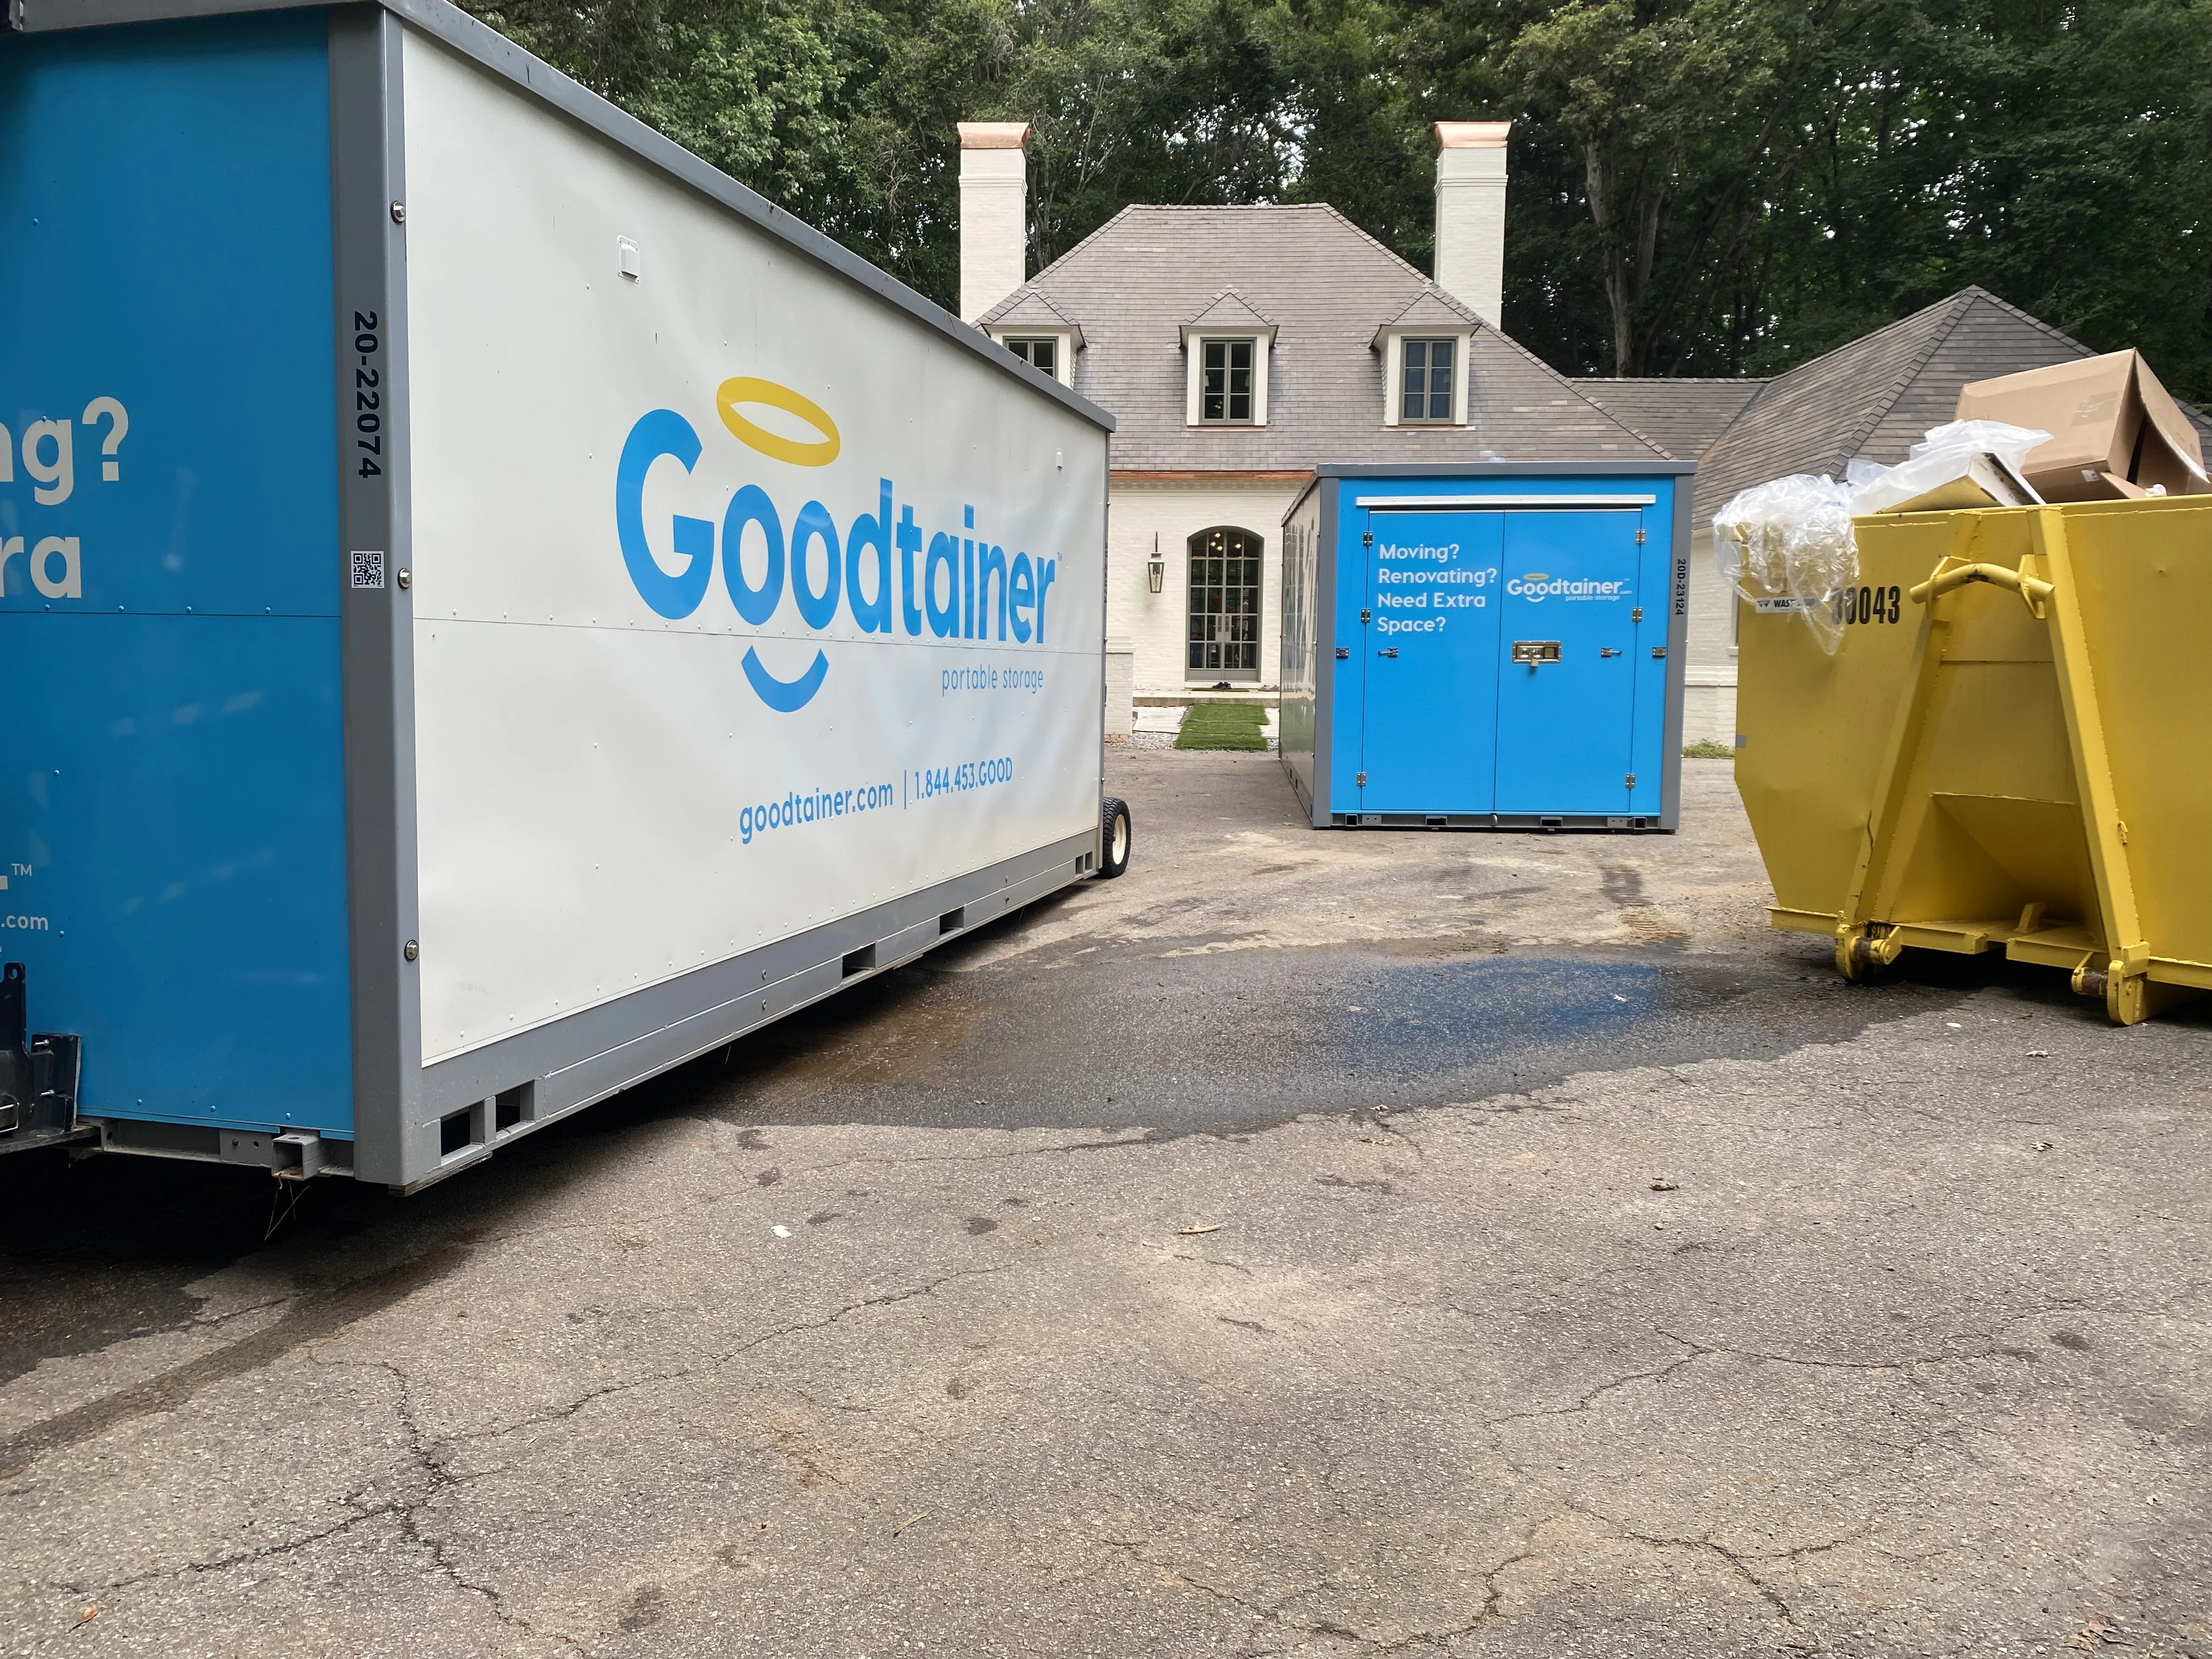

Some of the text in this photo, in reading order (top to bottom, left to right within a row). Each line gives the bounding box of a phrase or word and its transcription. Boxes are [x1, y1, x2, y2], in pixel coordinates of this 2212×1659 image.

[354, 311, 381, 478] 20-22074
[616, 408, 1056, 644] Goodtainer
[1379, 543, 1460, 563] Moving?
[1378, 568, 1498, 588] Renovating?
[1507, 578, 1623, 596] Goodtainer
[1675, 558, 1686, 616] 20D-23124
[1378, 592, 1486, 608] Need Extra
[1377, 616, 1447, 636] Space?
[943, 663, 1043, 697] portable storage
[740, 757, 1013, 845] goodtainer.com 1.844.453.GOOD
